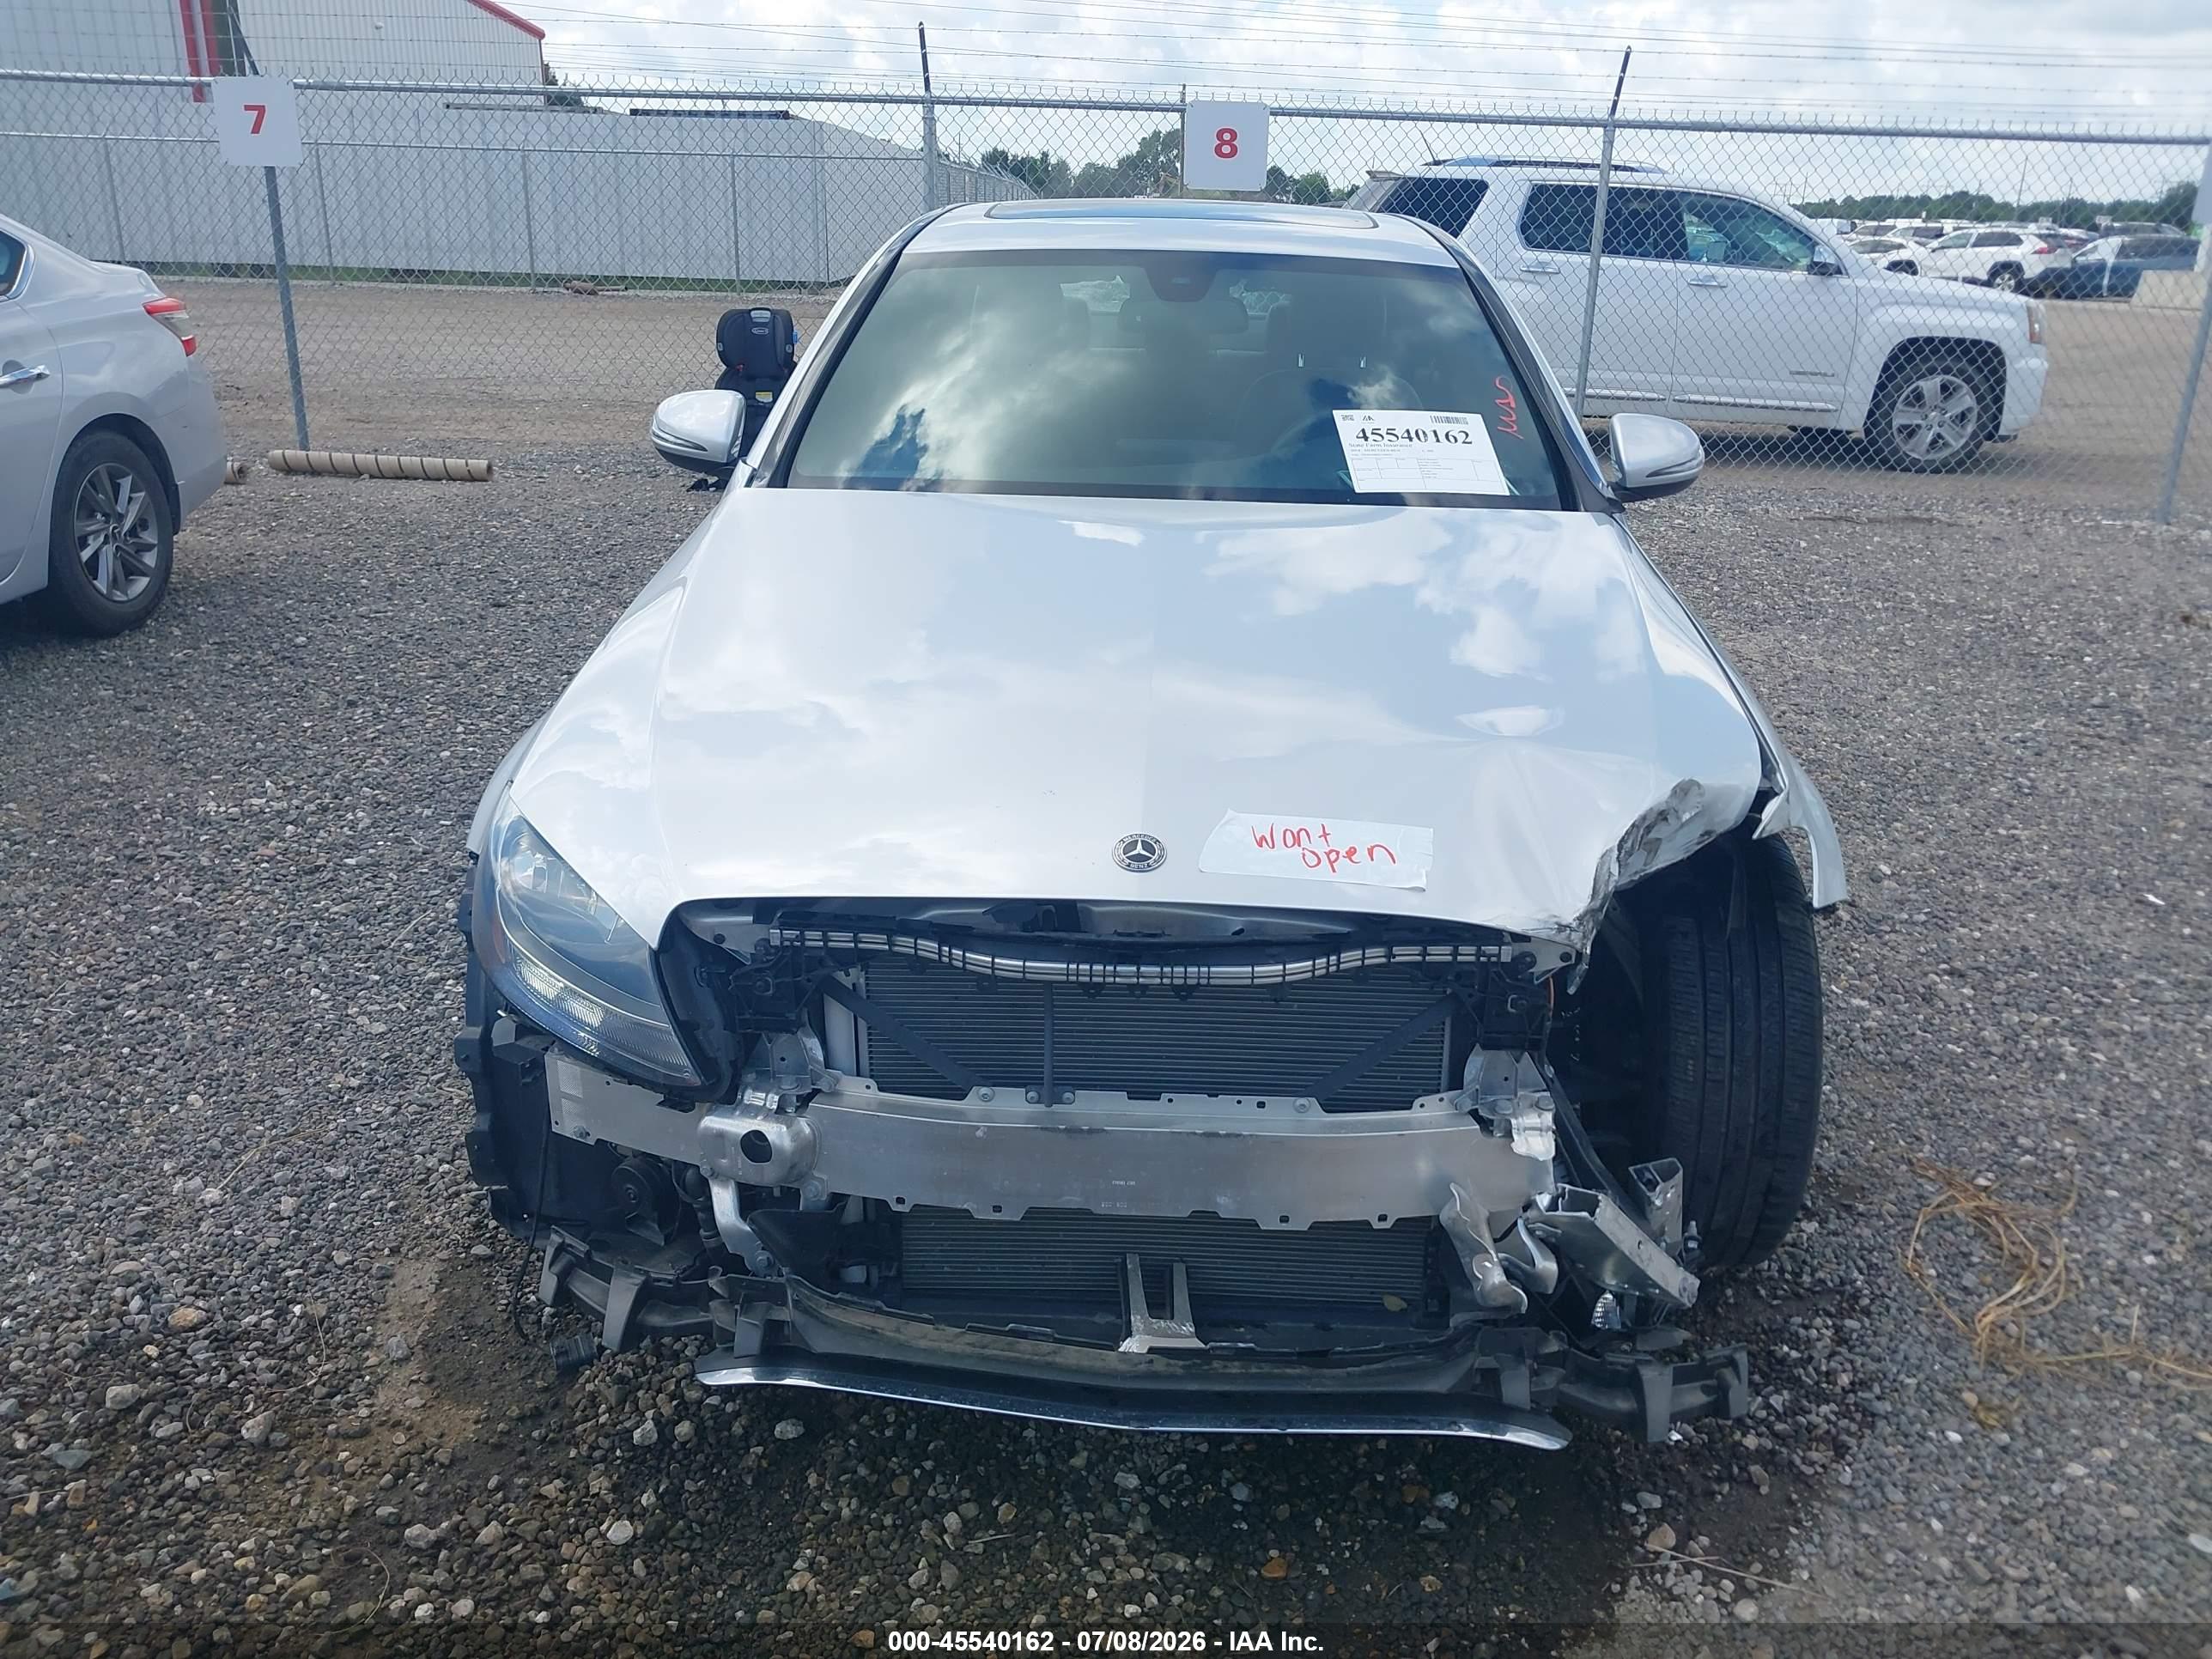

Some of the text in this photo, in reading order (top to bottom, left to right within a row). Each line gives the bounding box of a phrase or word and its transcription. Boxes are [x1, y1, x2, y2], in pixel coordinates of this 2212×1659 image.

[243, 104, 266, 135] 7
[1213, 127, 1238, 160] 8
[1356, 427, 1474, 446] 45540162
